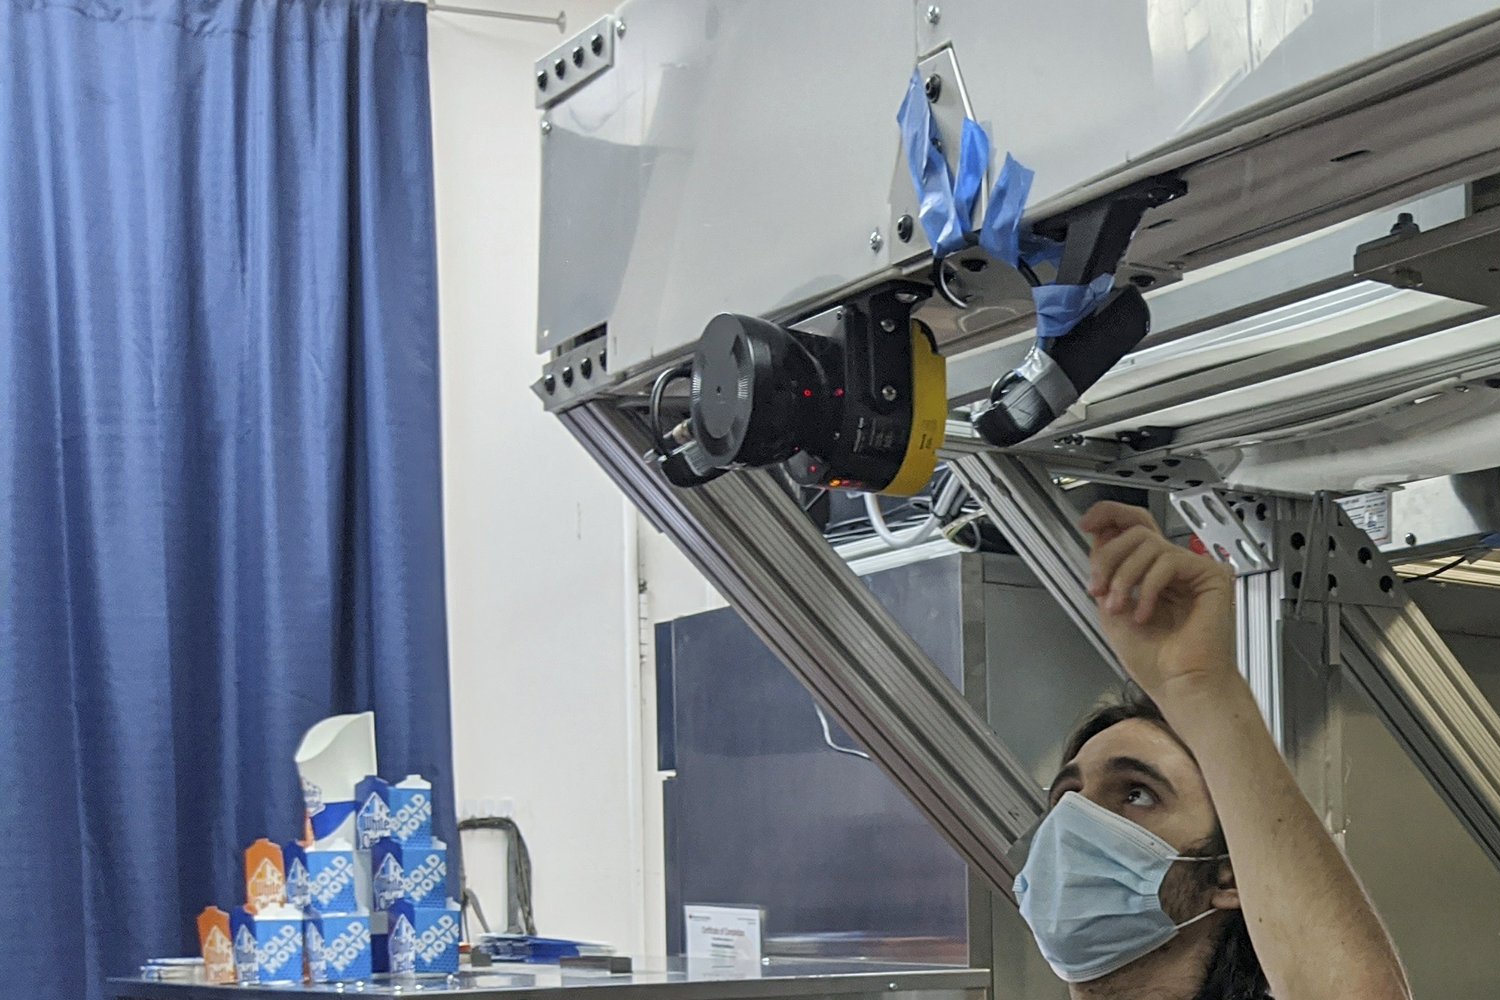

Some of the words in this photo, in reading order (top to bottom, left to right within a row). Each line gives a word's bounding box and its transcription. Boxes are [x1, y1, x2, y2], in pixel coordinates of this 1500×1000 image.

[387, 793, 426, 832] BOLD
[307, 855, 348, 895] BOLD
[401, 854, 441, 892] BOLD
[255, 924, 296, 963] BOLD
[323, 921, 364, 961] BOLD
[413, 915, 454, 953] BOLD
